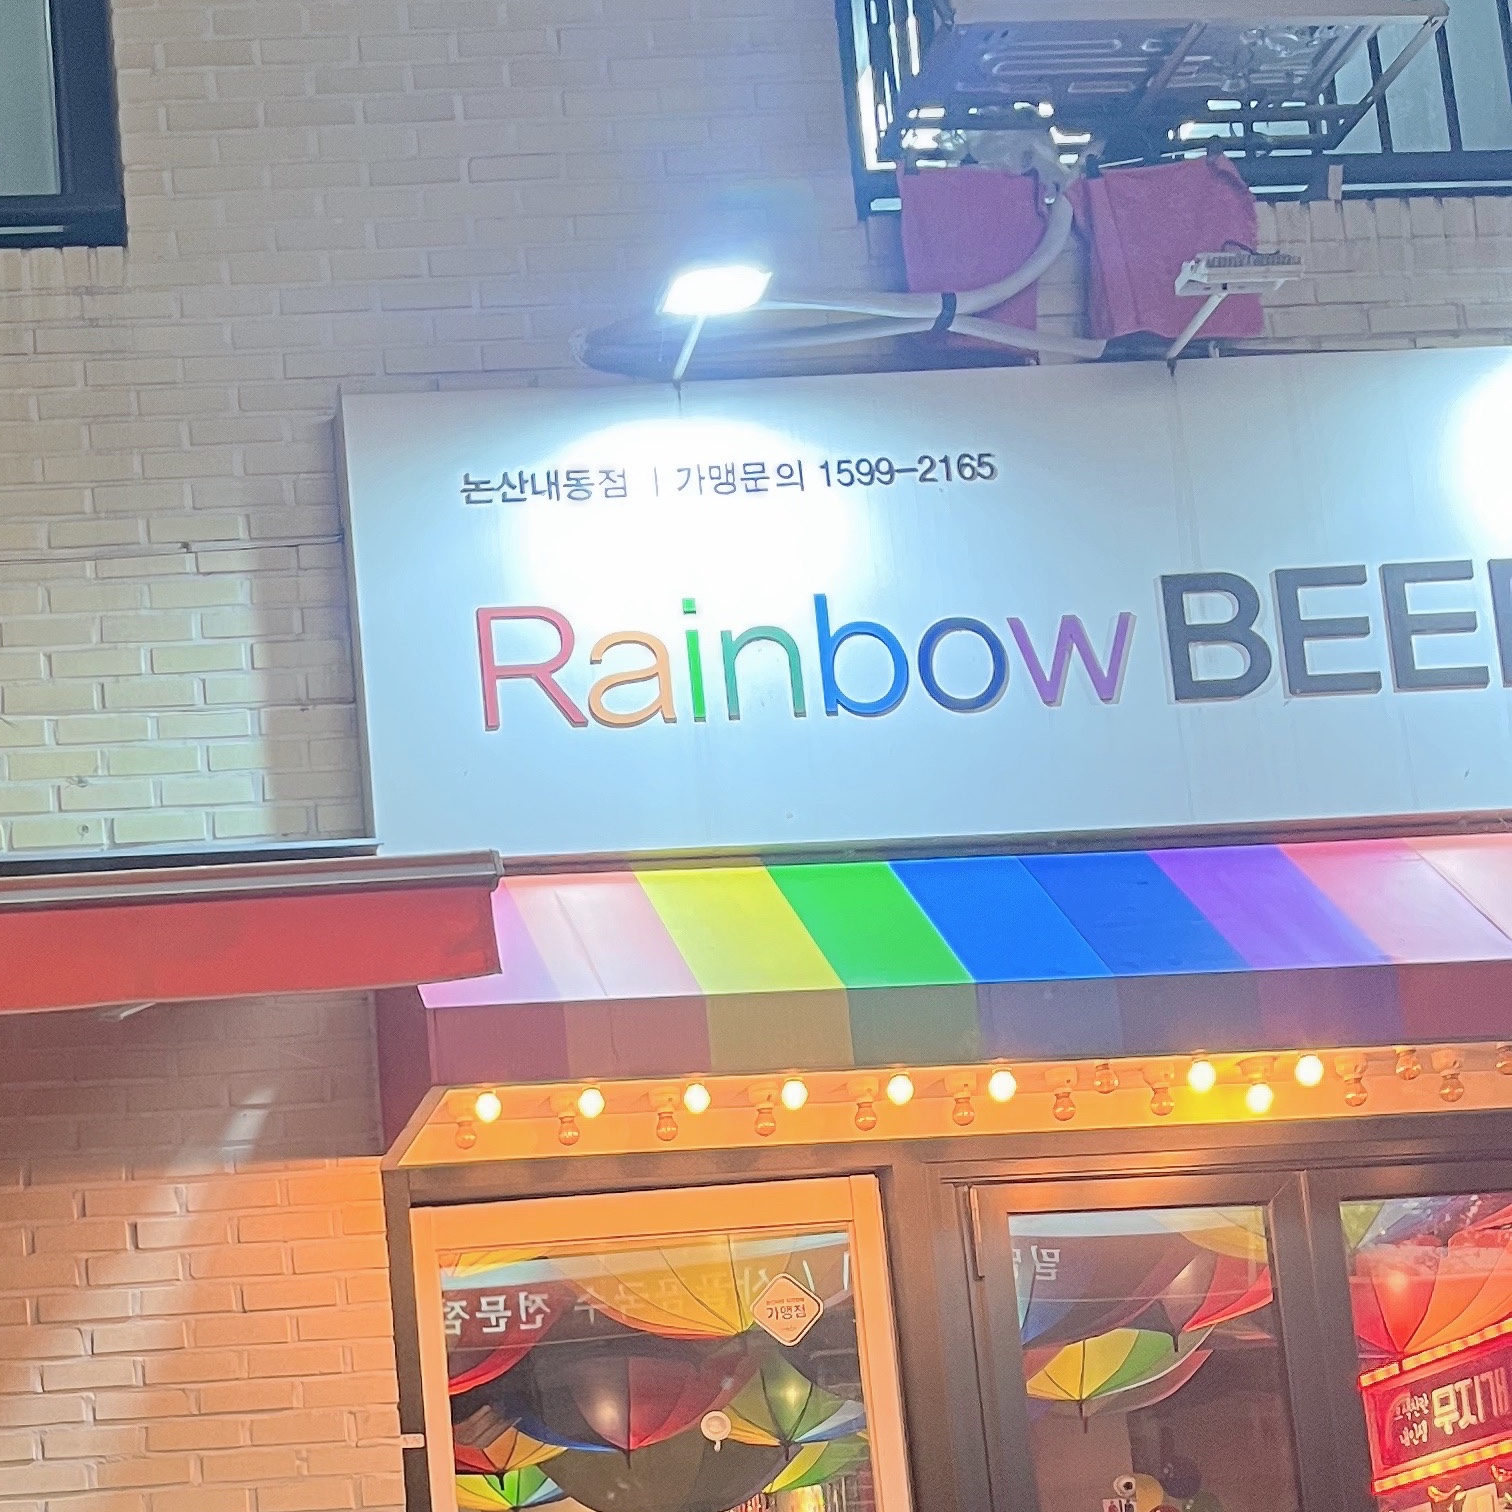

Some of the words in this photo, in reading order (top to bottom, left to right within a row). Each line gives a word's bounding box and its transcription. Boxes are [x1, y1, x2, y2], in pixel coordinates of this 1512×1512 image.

[460, 469, 629, 504] 논산내동점
[675, 460, 805, 495] 가맹문의
[818, 452, 998, 489] 1599-2165
[476, 594, 1136, 732] Rainbow
[1155, 558, 1512, 704] BEE
[766, 1304, 807, 1321] 가맹점
